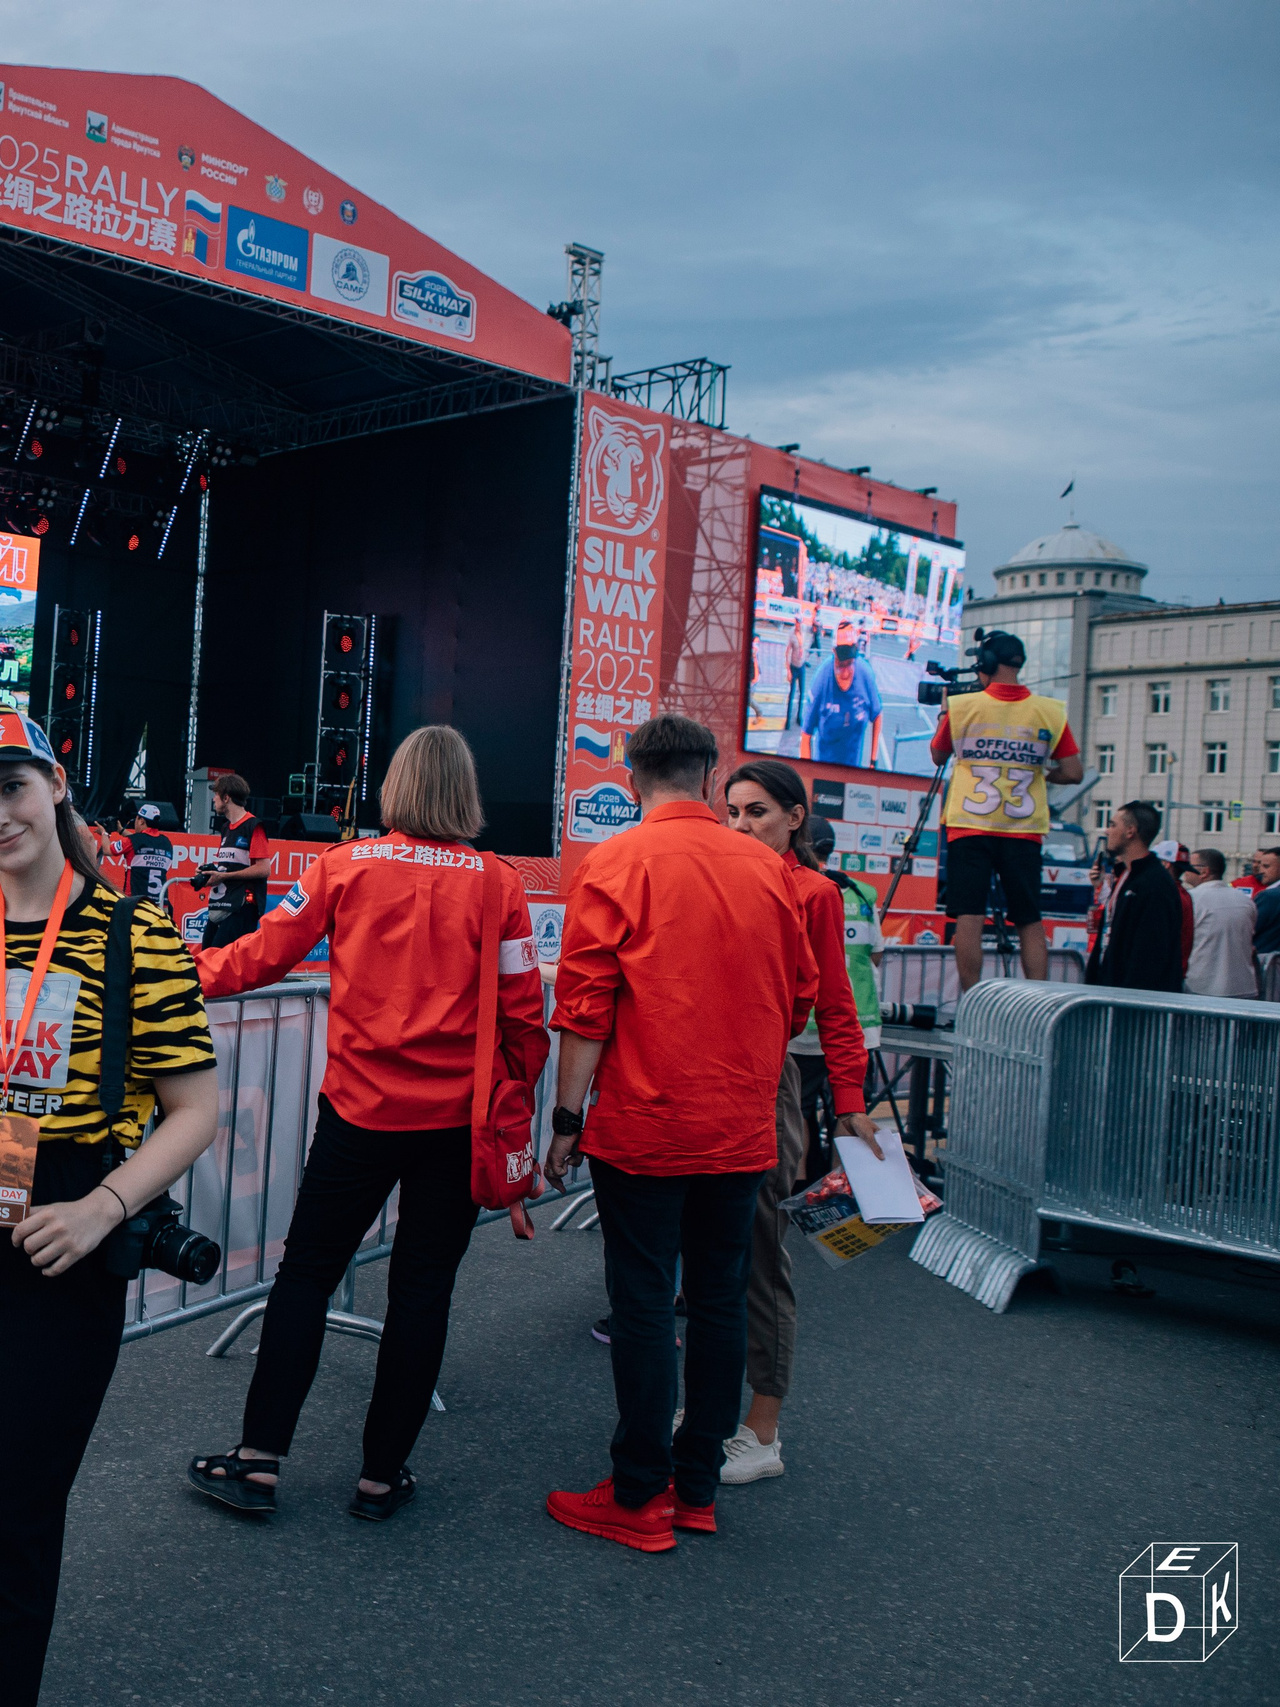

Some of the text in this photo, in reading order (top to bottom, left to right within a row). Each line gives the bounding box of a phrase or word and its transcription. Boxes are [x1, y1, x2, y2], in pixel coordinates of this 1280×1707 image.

[200, 166, 238, 186] РОССИИ
[201, 153, 249, 177] МИНСПОРТ
[65, 153, 180, 217] RALLY
[254, 244, 299, 272] ГАЗПРОМ
[236, 258, 297, 283] ГЕНЕРАЛЬНЫЙ ПАРТНЕР
[336, 280, 365, 295] CAMF
[402, 284, 468, 313] SILK WAY
[424, 280, 448, 294] 2025
[421, 303, 449, 315] RALLY
[582, 535, 657, 585] SILK
[582, 574, 657, 623] WAY
[579, 618, 655, 657] RALLY
[577, 648, 654, 697] 2025
[575, 690, 652, 726] 丝绸之路
[962, 749, 1044, 765] BROADCASTER
[975, 738, 1037, 754] OFFICIAL
[598, 793, 620, 803] 2025
[962, 765, 1036, 819] 33
[578, 802, 639, 819] SILK WAY
[142, 854, 167, 863] OFFICIAL
[145, 860, 165, 868] PHOTO
[147, 869, 163, 895] 5
[1, 1189, 24, 1200] DAY
